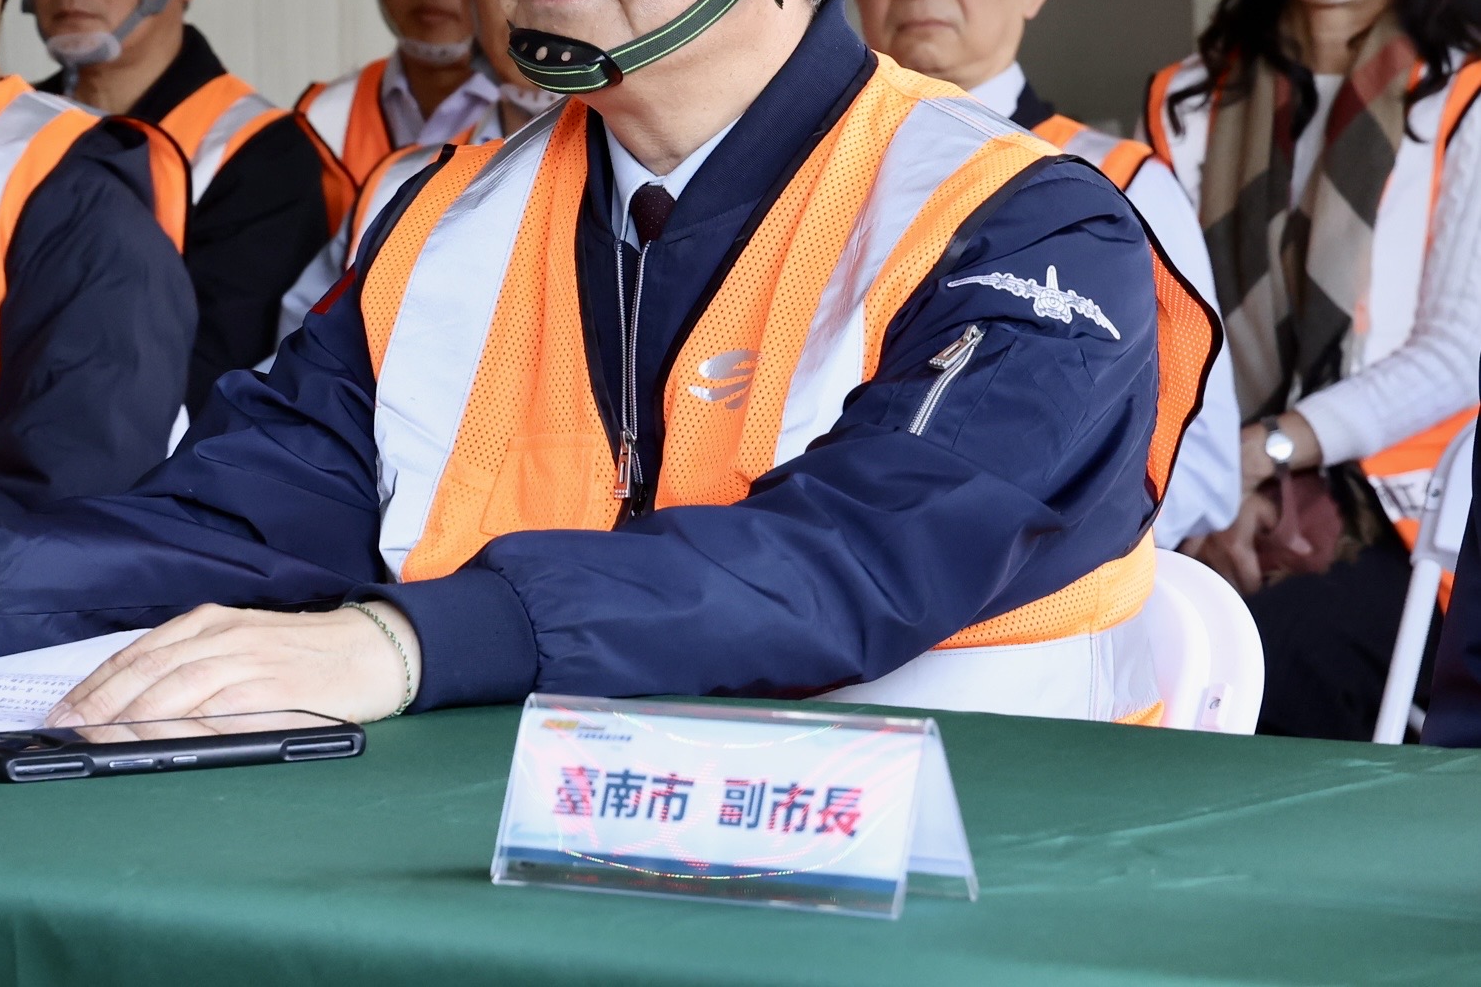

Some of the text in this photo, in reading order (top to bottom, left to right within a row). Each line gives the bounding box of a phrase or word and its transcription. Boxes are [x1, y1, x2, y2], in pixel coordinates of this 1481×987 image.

[552, 765, 864, 838] 臺南市 副市長
